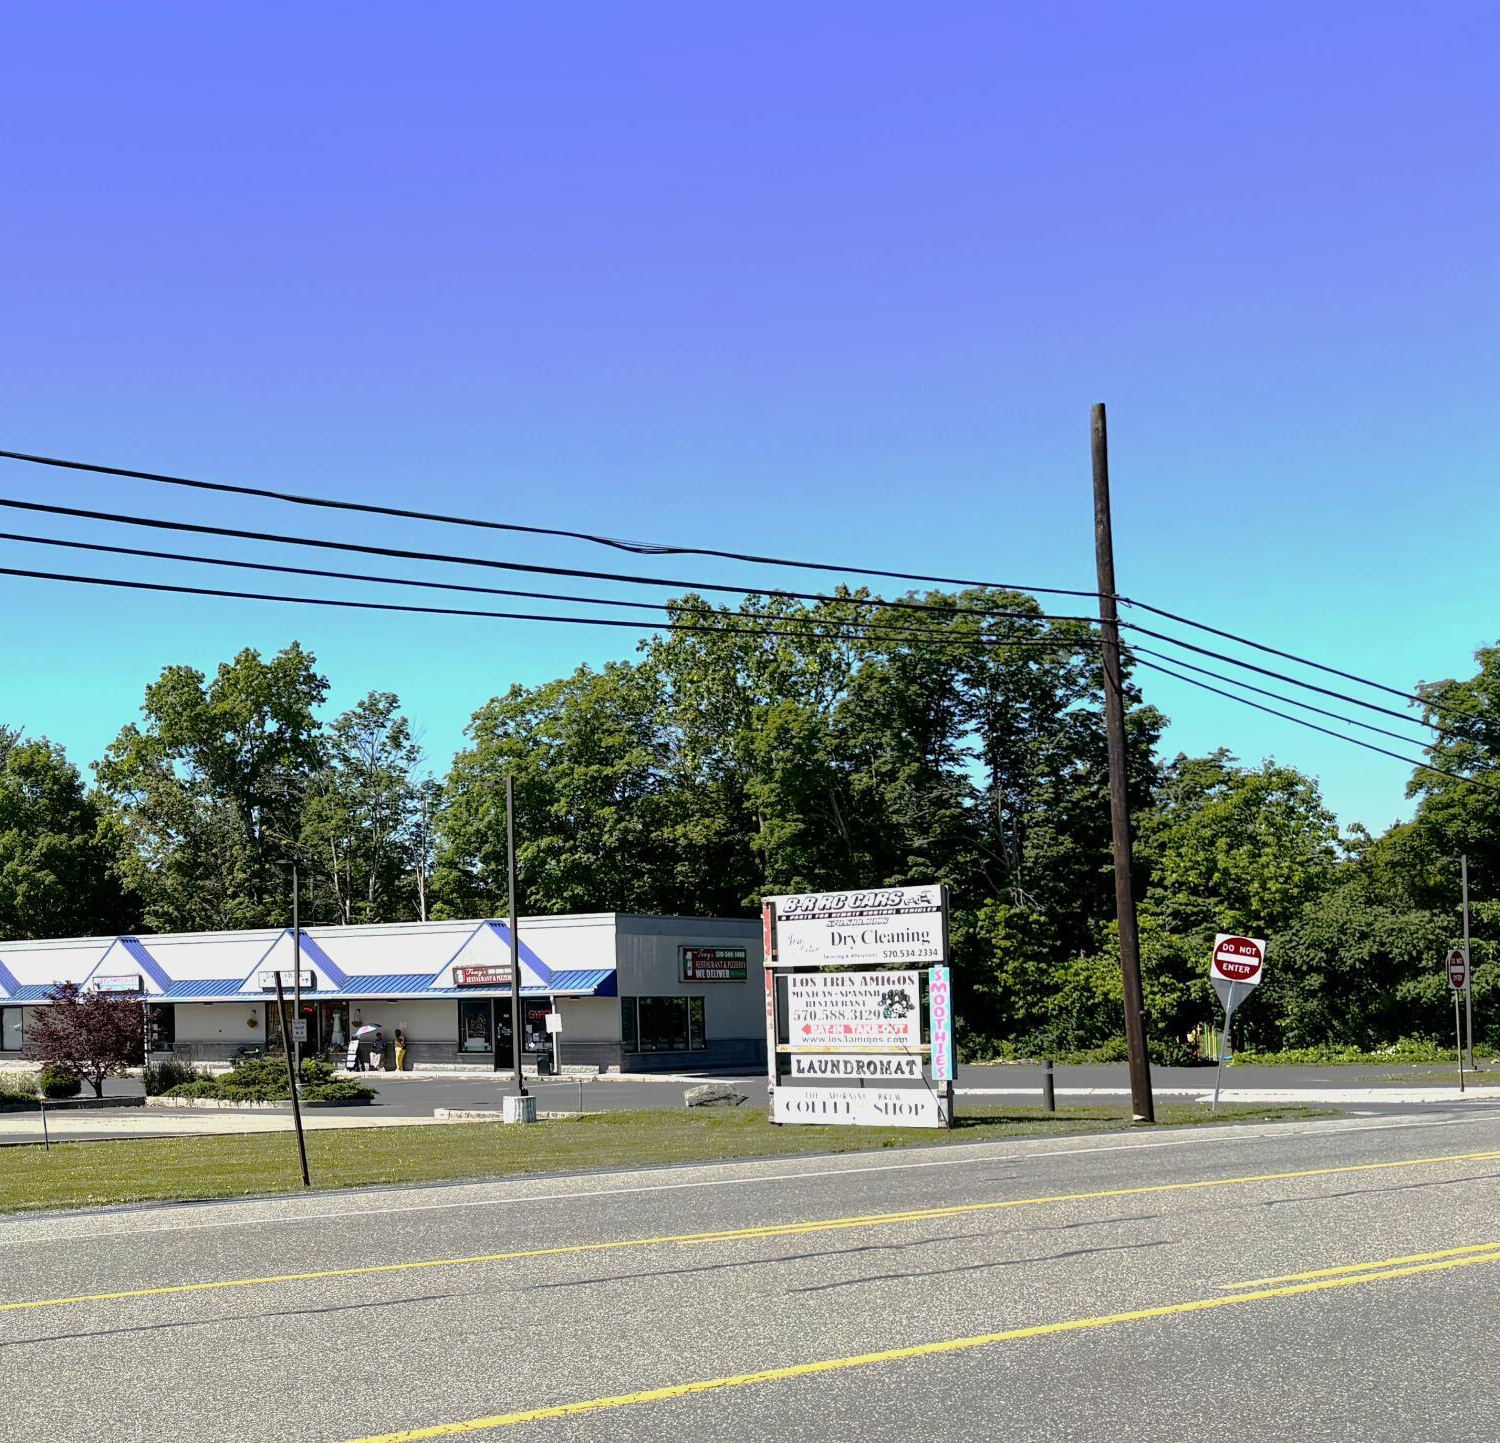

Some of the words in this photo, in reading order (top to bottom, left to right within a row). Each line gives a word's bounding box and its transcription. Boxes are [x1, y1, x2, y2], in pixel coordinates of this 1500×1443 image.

[783, 897, 815, 913] B-R
[817, 893, 847, 910] RC
[848, 891, 904, 909] CARS
[831, 931, 858, 949] Dry
[861, 928, 930, 945] Cleaning
[883, 948, 938, 959] 570.534.2334
[1222, 943, 1235, 952] DO
[1239, 946, 1257, 955] NOT
[695, 969, 706, 979] WE
[706, 969, 730, 978] DELIVER
[1222, 963, 1251, 974] ENTER
[792, 977, 817, 988] LOS
[823, 976, 855, 987] TRES
[860, 975, 915, 986] AMIGOS
[793, 1009, 881, 1021] 570.588.3129
[931, 970, 948, 1078] SMOOTHIES
[796, 1059, 918, 1076] LAUNDROMAT
[874, 1102, 925, 1116] SHOP
